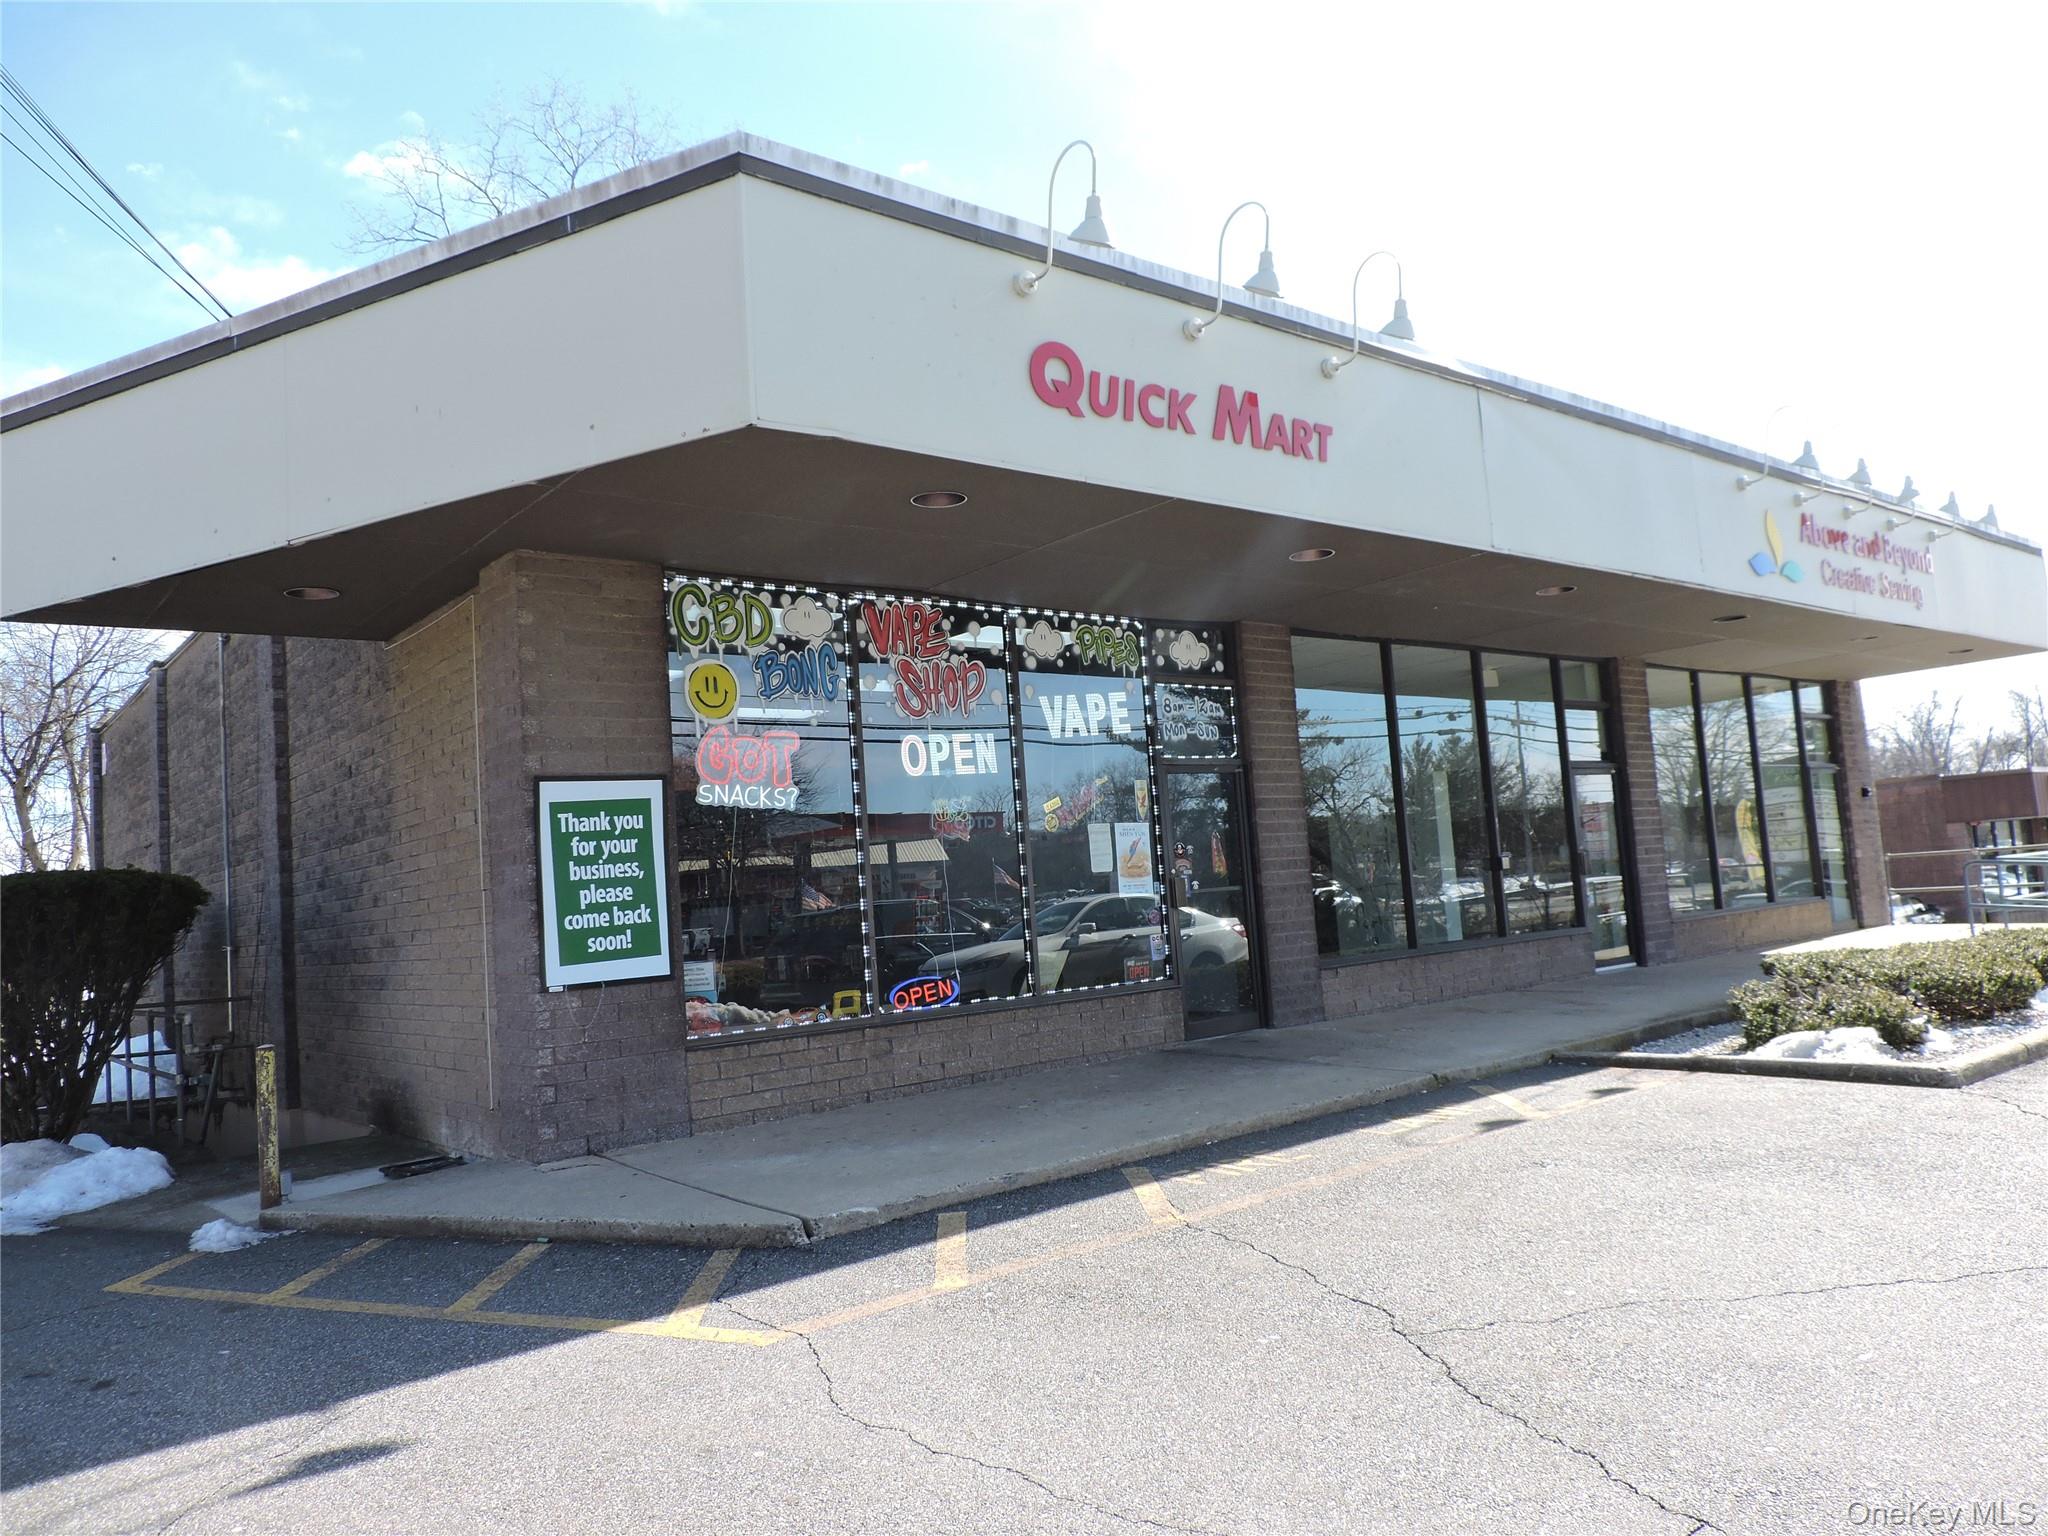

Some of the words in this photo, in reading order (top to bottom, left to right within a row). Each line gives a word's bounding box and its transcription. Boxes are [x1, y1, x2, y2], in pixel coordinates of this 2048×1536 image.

[1029, 341, 1197, 434] QUICK
[1213, 384, 1333, 462] MART
[1800, 512, 1849, 554] Above
[1853, 531, 1881, 560] and
[1820, 559, 1876, 595] Creative
[1881, 572, 1923, 610] Sewing
[672, 584, 774, 647] CBD
[862, 602, 950, 659] VAPE
[1076, 625, 1139, 667] PIPES
[754, 643, 839, 699] BONG
[896, 657, 986, 719] SHOP
[1039, 692, 1131, 738] VAPE
[697, 725, 800, 787] GOT
[901, 734, 998, 776] OPEN
[698, 784, 798, 808] SNACKS?
[557, 811, 611, 833] Thank
[614, 814, 643, 835] you
[571, 837, 597, 857] for
[600, 838, 638, 859] your
[569, 860, 645, 881] business,
[564, 910, 610, 930] come
[613, 904, 652, 926] back
[580, 883, 633, 909] please
[588, 929, 632, 953] soon!
[894, 979, 952, 1009] OPEN
